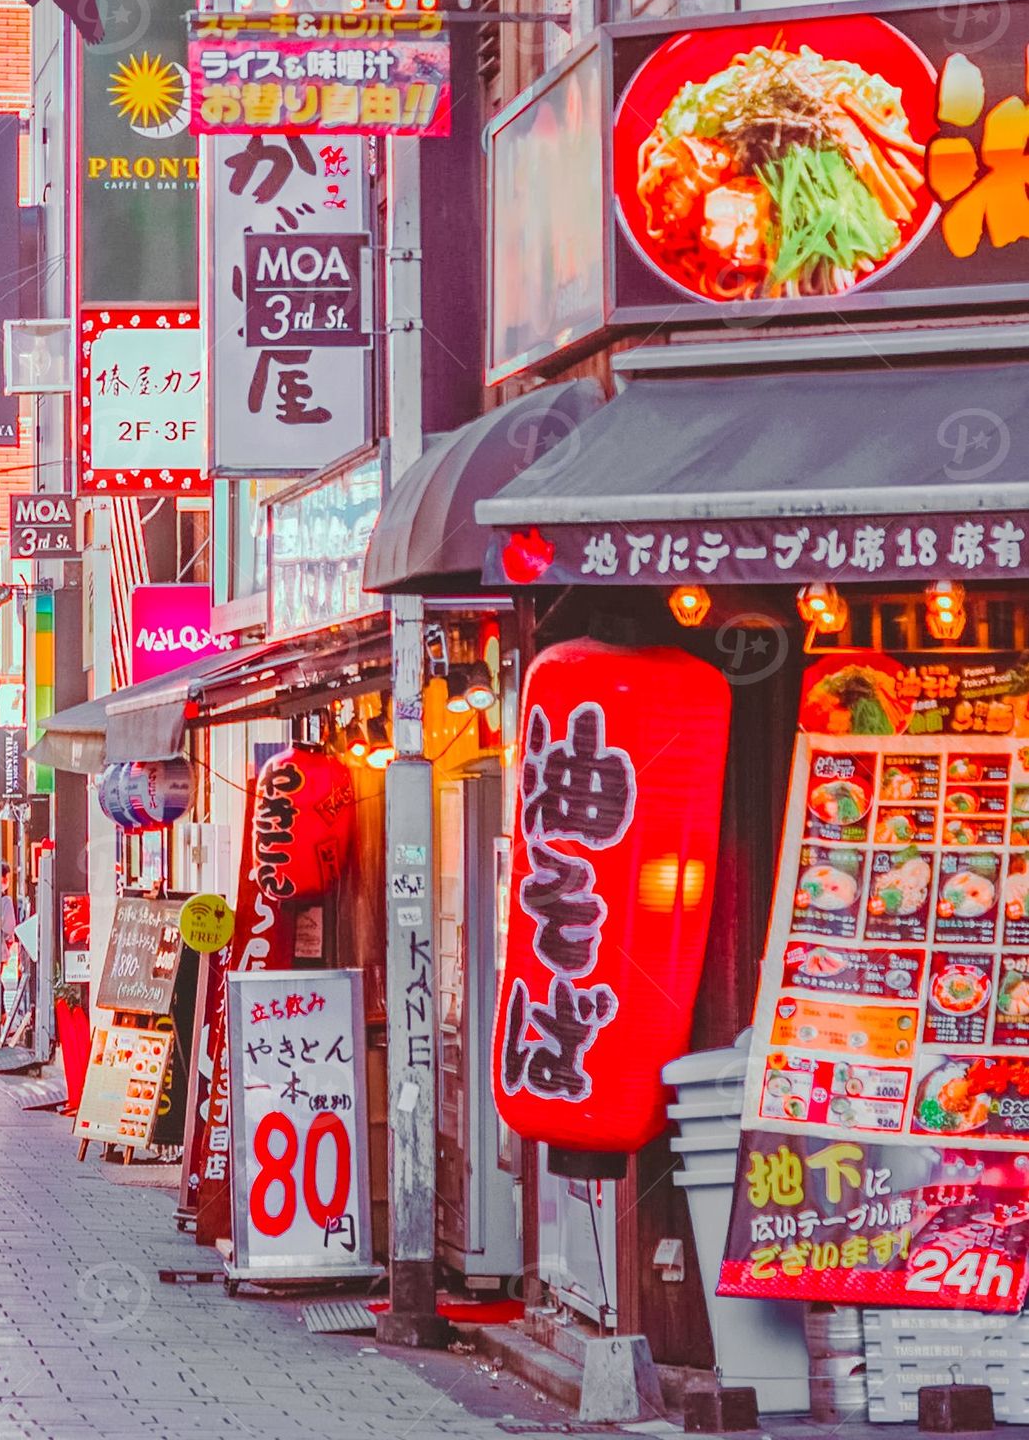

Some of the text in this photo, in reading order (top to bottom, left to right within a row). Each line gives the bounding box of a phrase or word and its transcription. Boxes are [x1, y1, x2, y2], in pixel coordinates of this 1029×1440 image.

[88, 157, 199, 178] PRONT
[256, 246, 350, 282] MOA
[260, 294, 349, 341] 3rd St.
[15, 501, 71, 522] MOA
[19, 528, 70, 556] 3rd St.
[502, 702, 636, 1102] 油そば
[190, 931, 222, 944] FREE
[251, 993, 325, 1024] 立ち飲み
[245, 1035, 354, 1068] やきとん
[747, 1146, 892, 1208] 地下に
[750, 1199, 912, 1242] 広いテーブル席
[905, 1250, 1014, 1297] 24h
